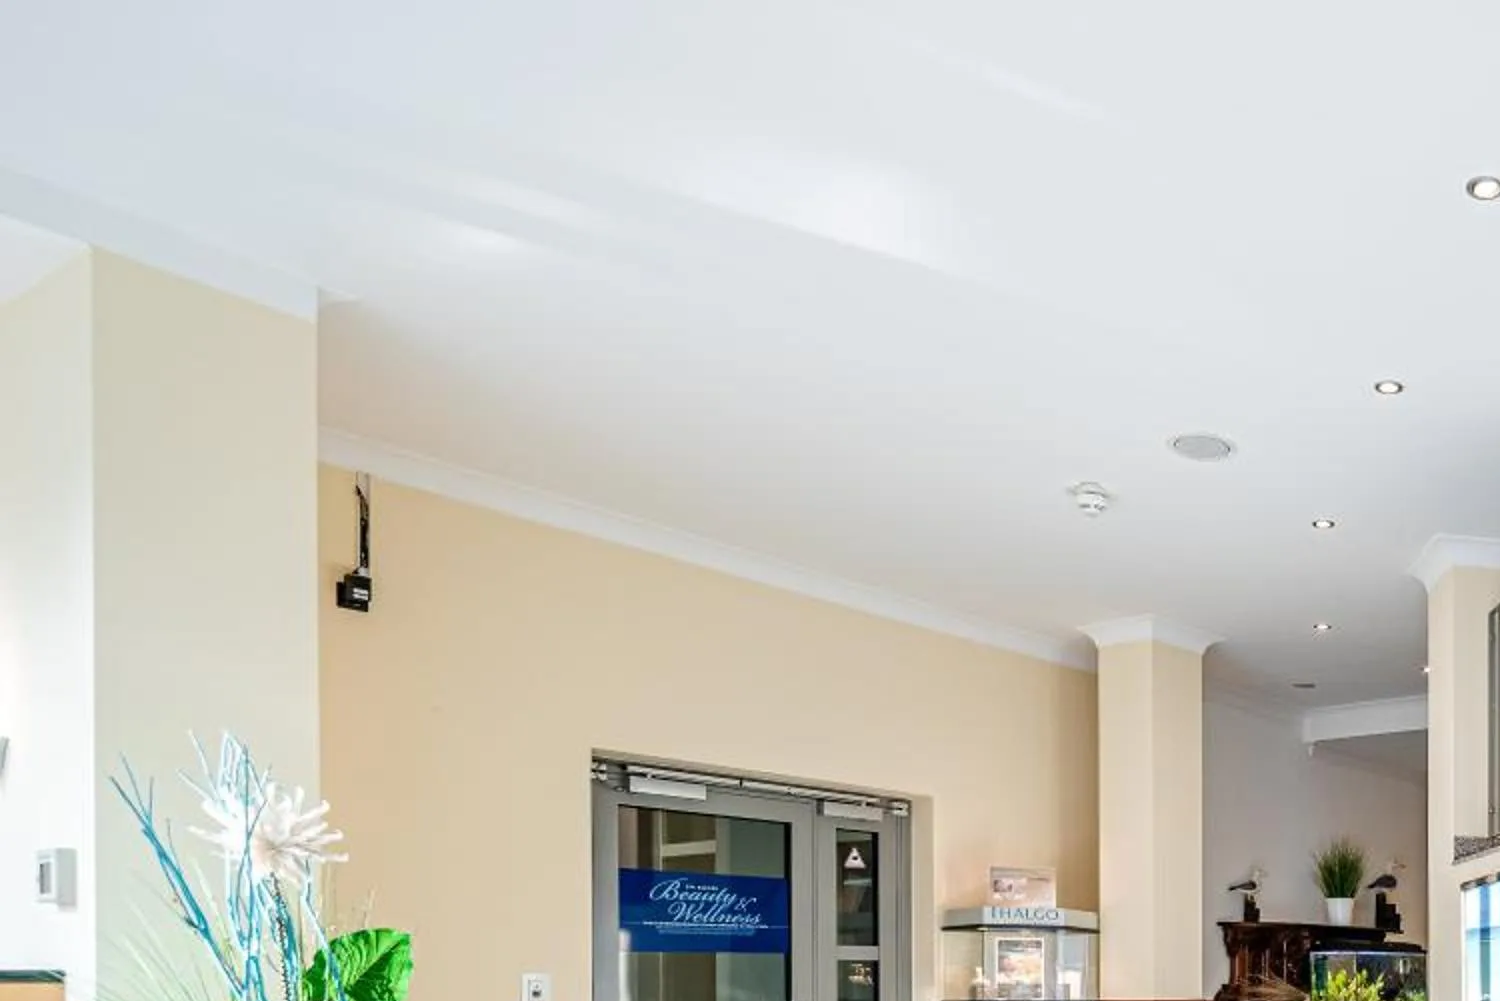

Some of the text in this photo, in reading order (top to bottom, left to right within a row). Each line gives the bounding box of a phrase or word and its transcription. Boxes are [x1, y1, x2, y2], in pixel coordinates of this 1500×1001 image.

[649, 878, 757, 912] Beauty &
[667, 901, 762, 924] Wellness
[991, 906, 1059, 921] THALGO
